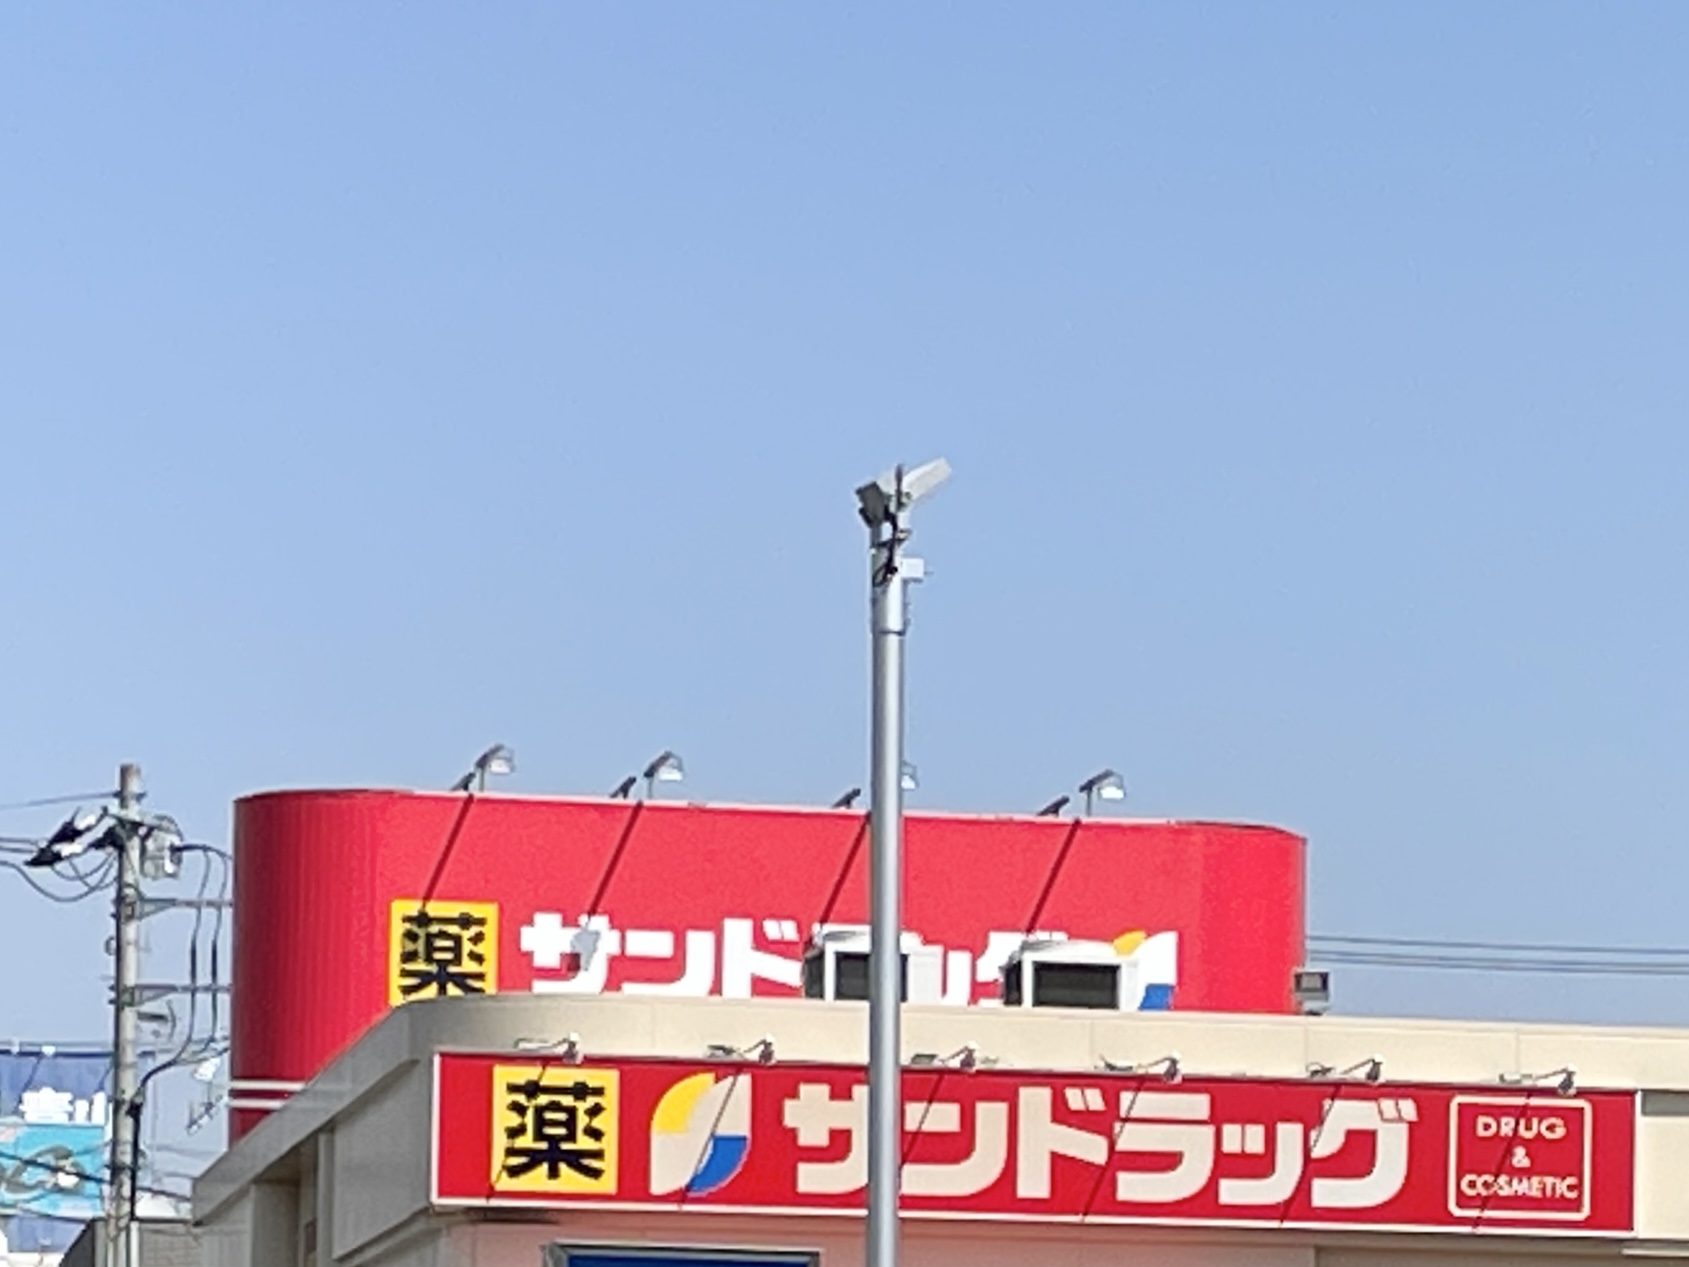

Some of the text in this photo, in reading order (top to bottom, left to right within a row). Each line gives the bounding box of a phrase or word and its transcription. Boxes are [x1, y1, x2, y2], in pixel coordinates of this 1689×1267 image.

[400, 910, 488, 995] 薬
[1475, 1115, 1567, 1139] DRUG
[504, 1079, 1419, 1208] 薬 サンドラッグ
[1511, 1145, 1531, 1168] &
[1460, 1173, 1579, 1199] COSMETIC
